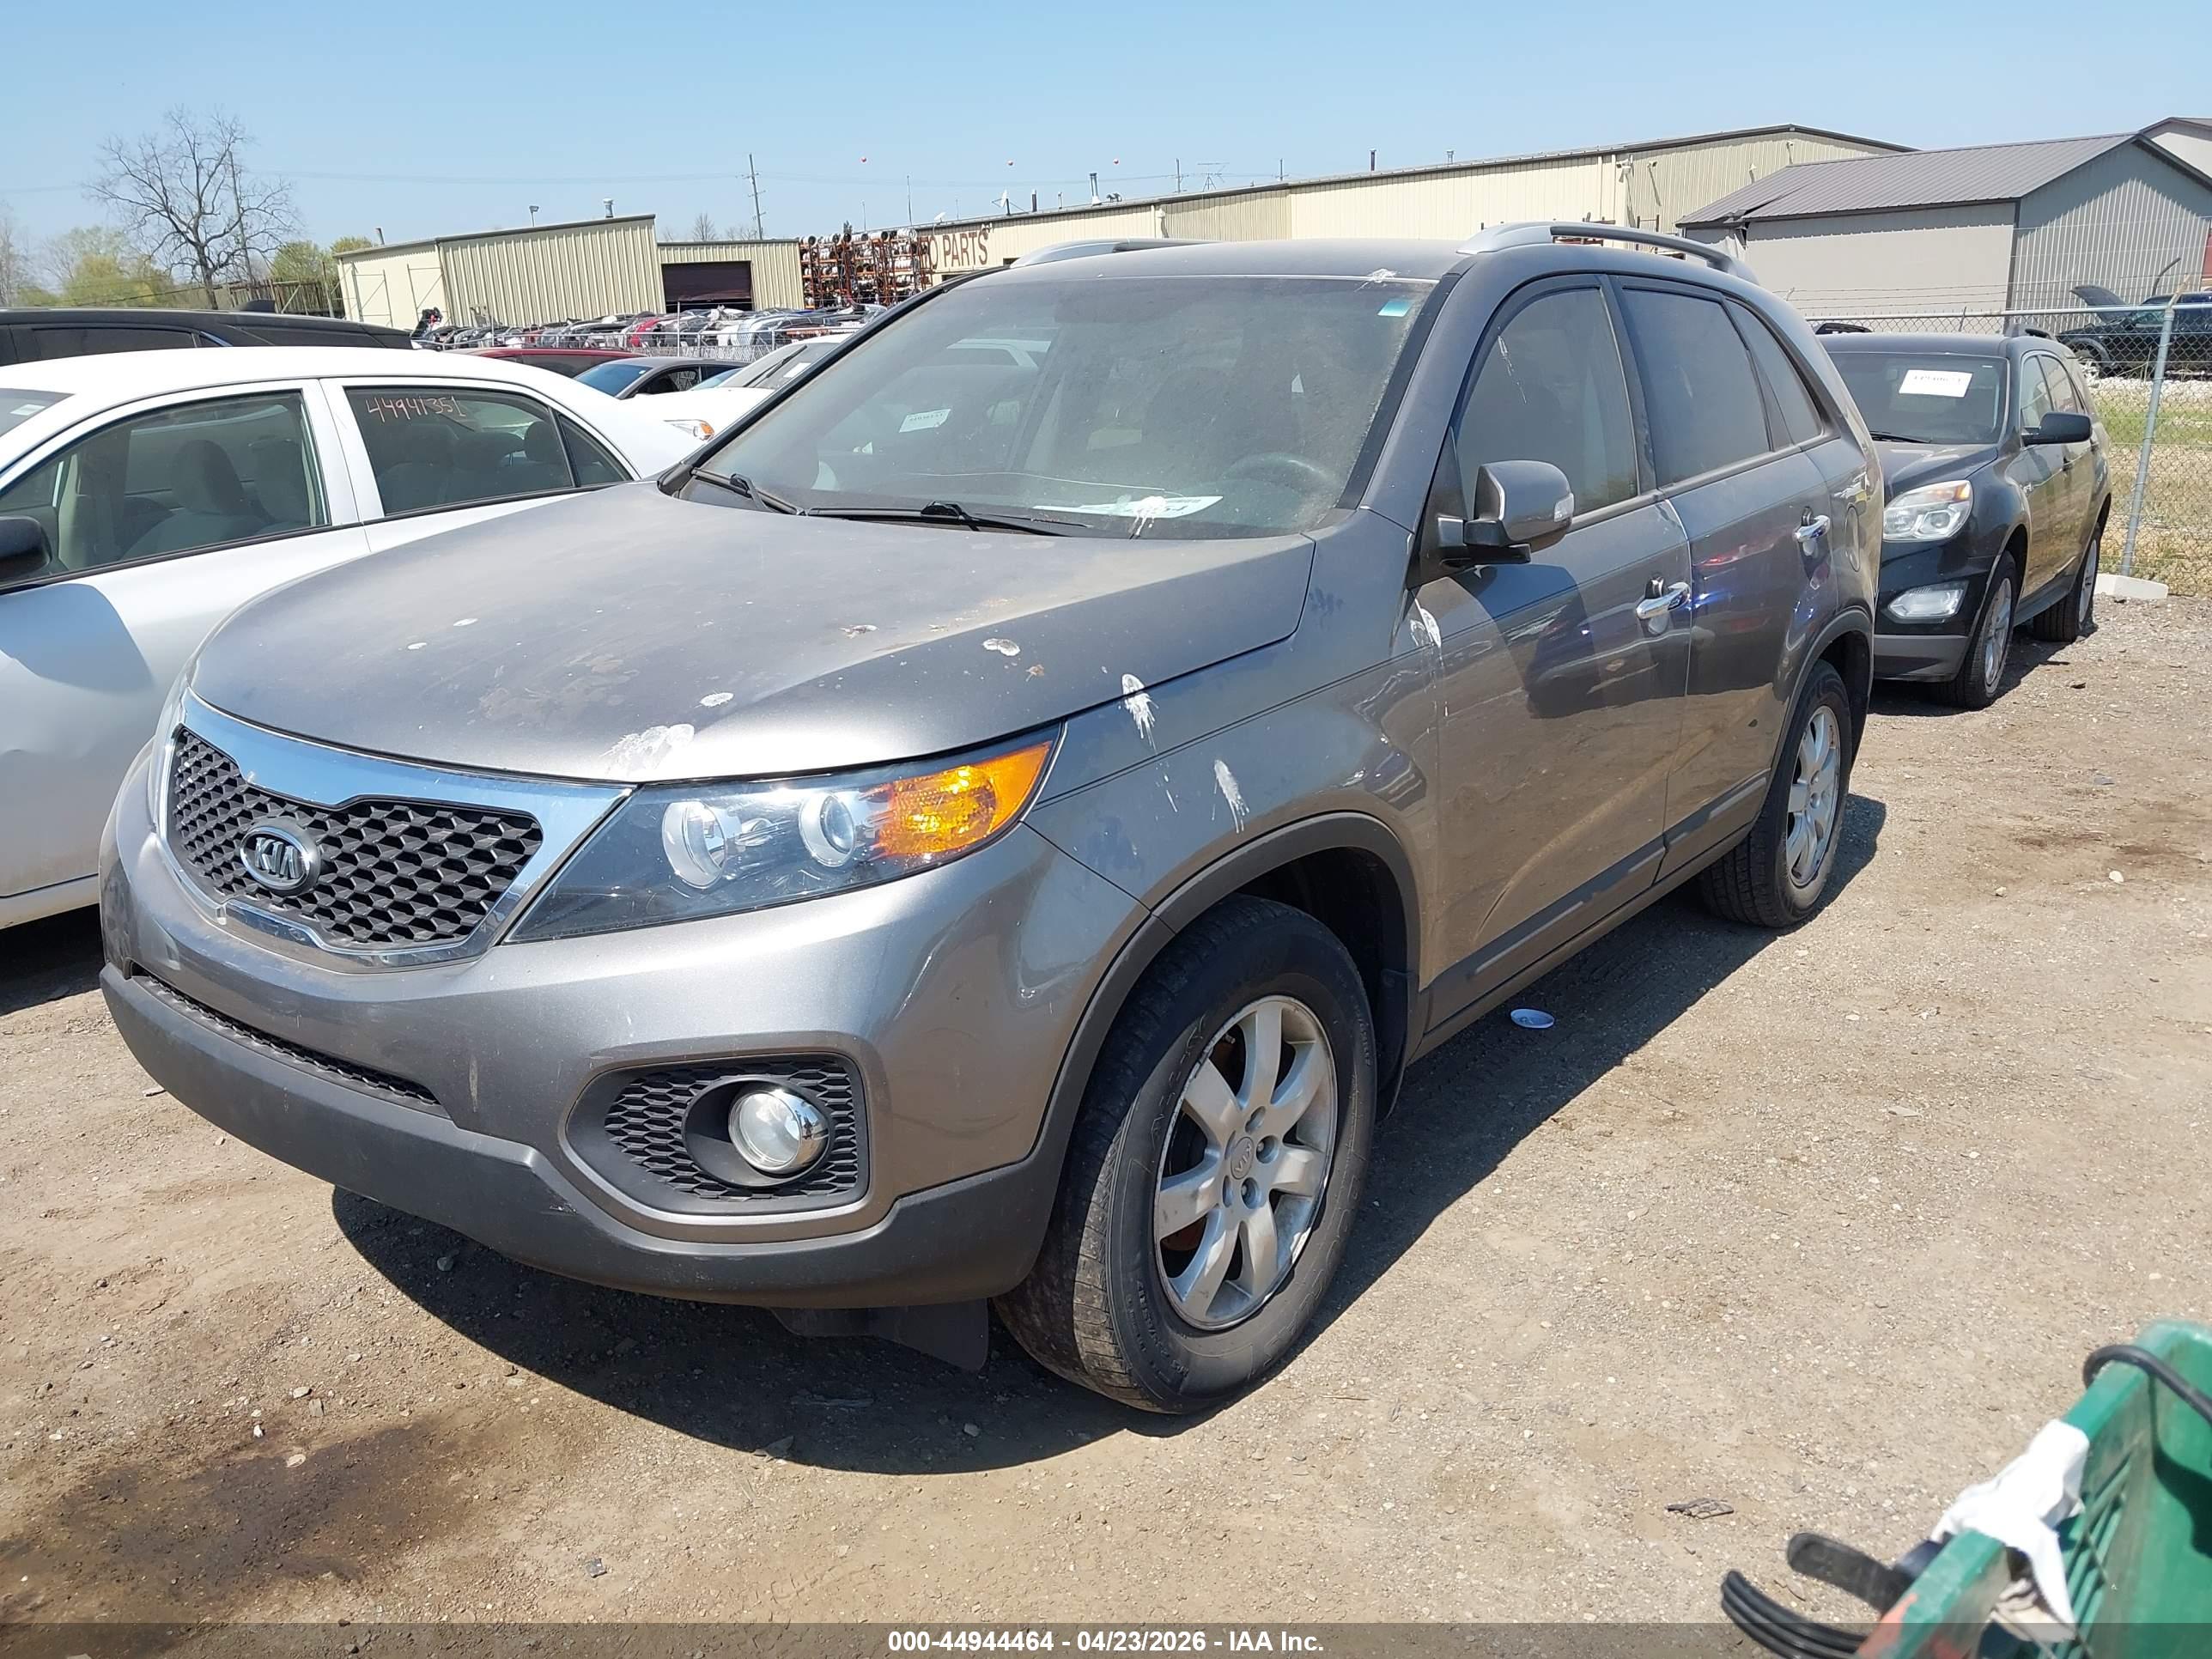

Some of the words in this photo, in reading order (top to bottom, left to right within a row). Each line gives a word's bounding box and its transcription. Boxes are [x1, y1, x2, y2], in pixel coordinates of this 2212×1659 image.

[942, 228, 988, 268] PARTS
[365, 396, 466, 422] 44941351
[254, 836, 301, 880] KIA
